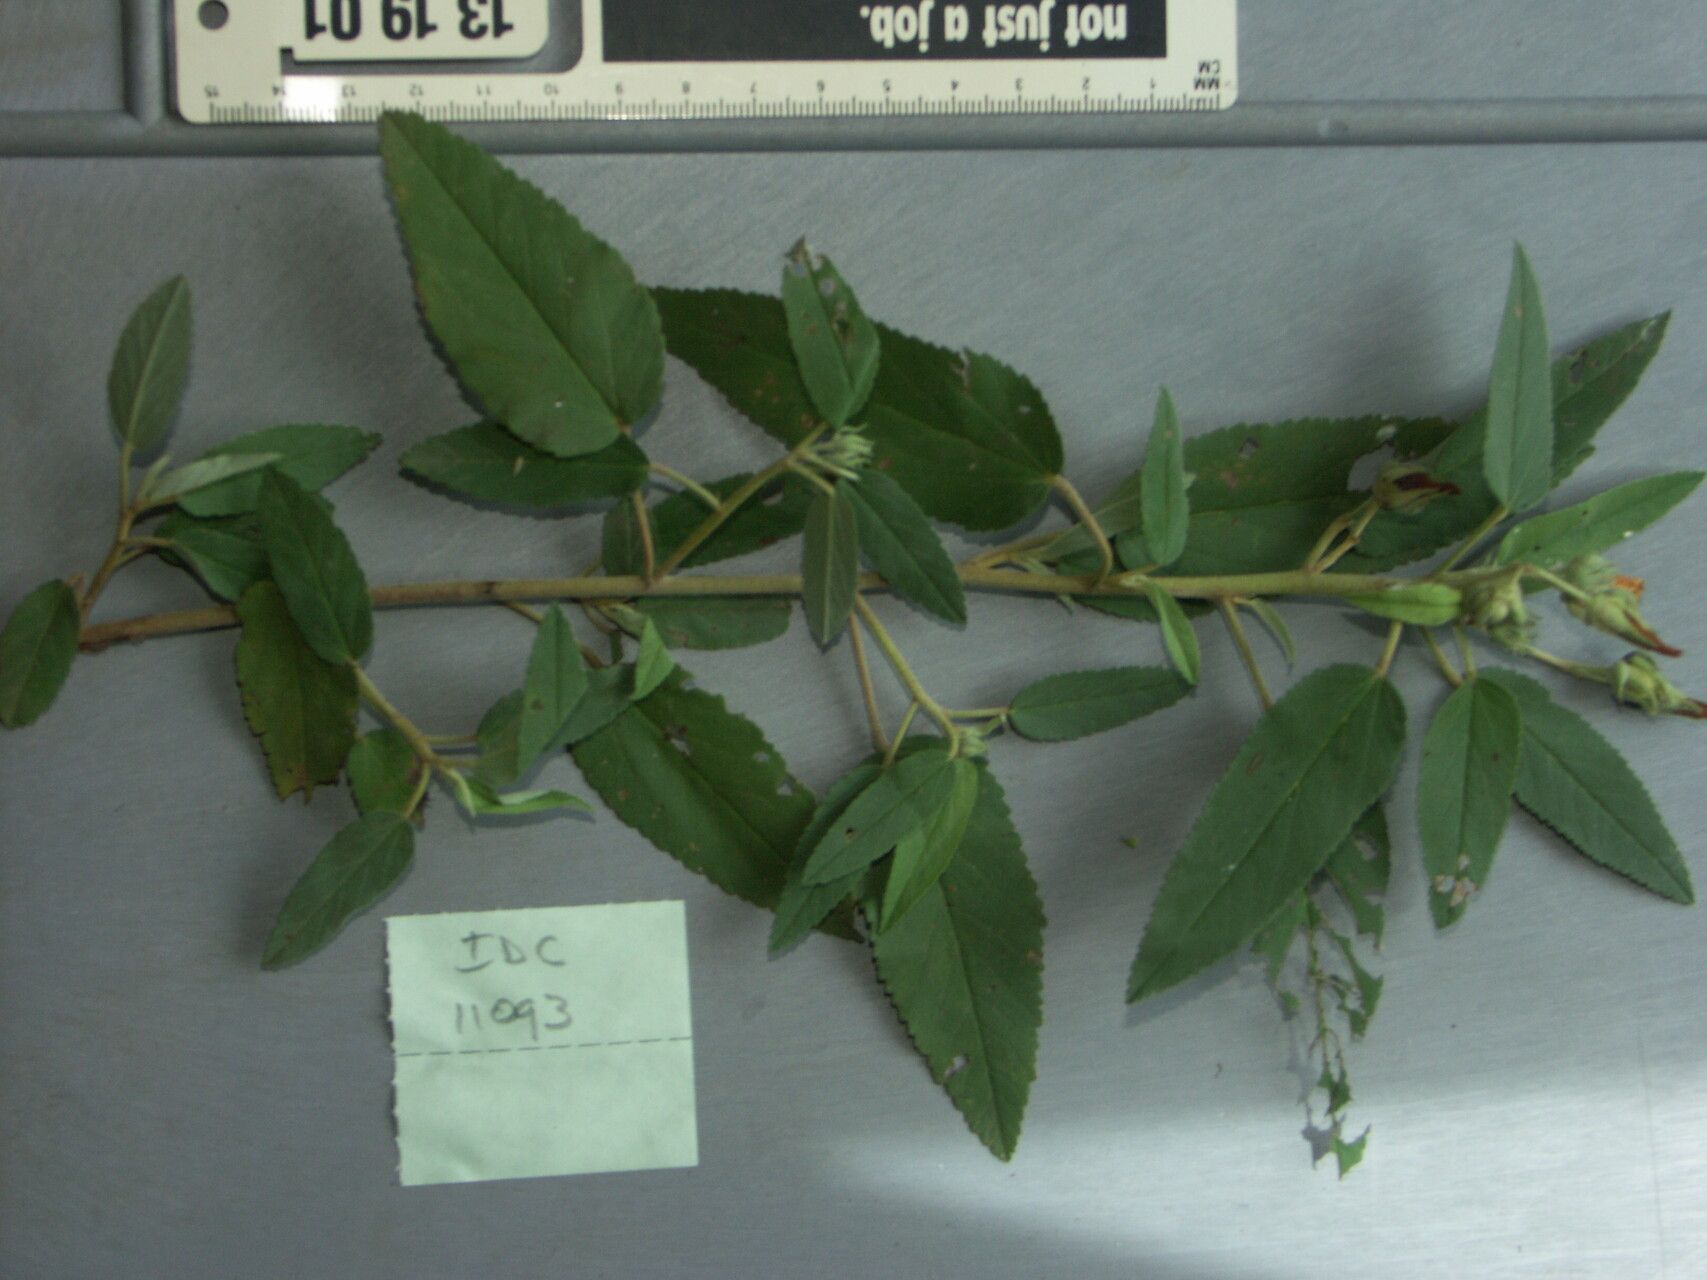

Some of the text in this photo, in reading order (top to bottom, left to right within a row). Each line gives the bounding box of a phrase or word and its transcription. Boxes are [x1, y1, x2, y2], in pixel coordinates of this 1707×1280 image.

[303, 0, 514, 40] 13 19 01
[860, 0, 1127, 52] not just a job.
[1199, 59, 1221, 74] CM
[204, 85, 219, 97] 15
[342, 84, 356, 97] 13
[409, 84, 424, 96] 12
[476, 85, 491, 95] 11
[543, 83, 559, 96] 10
[1194, 77, 1220, 91] MM
[455, 931, 566, 973] IDC
[454, 994, 573, 1041] 11093
